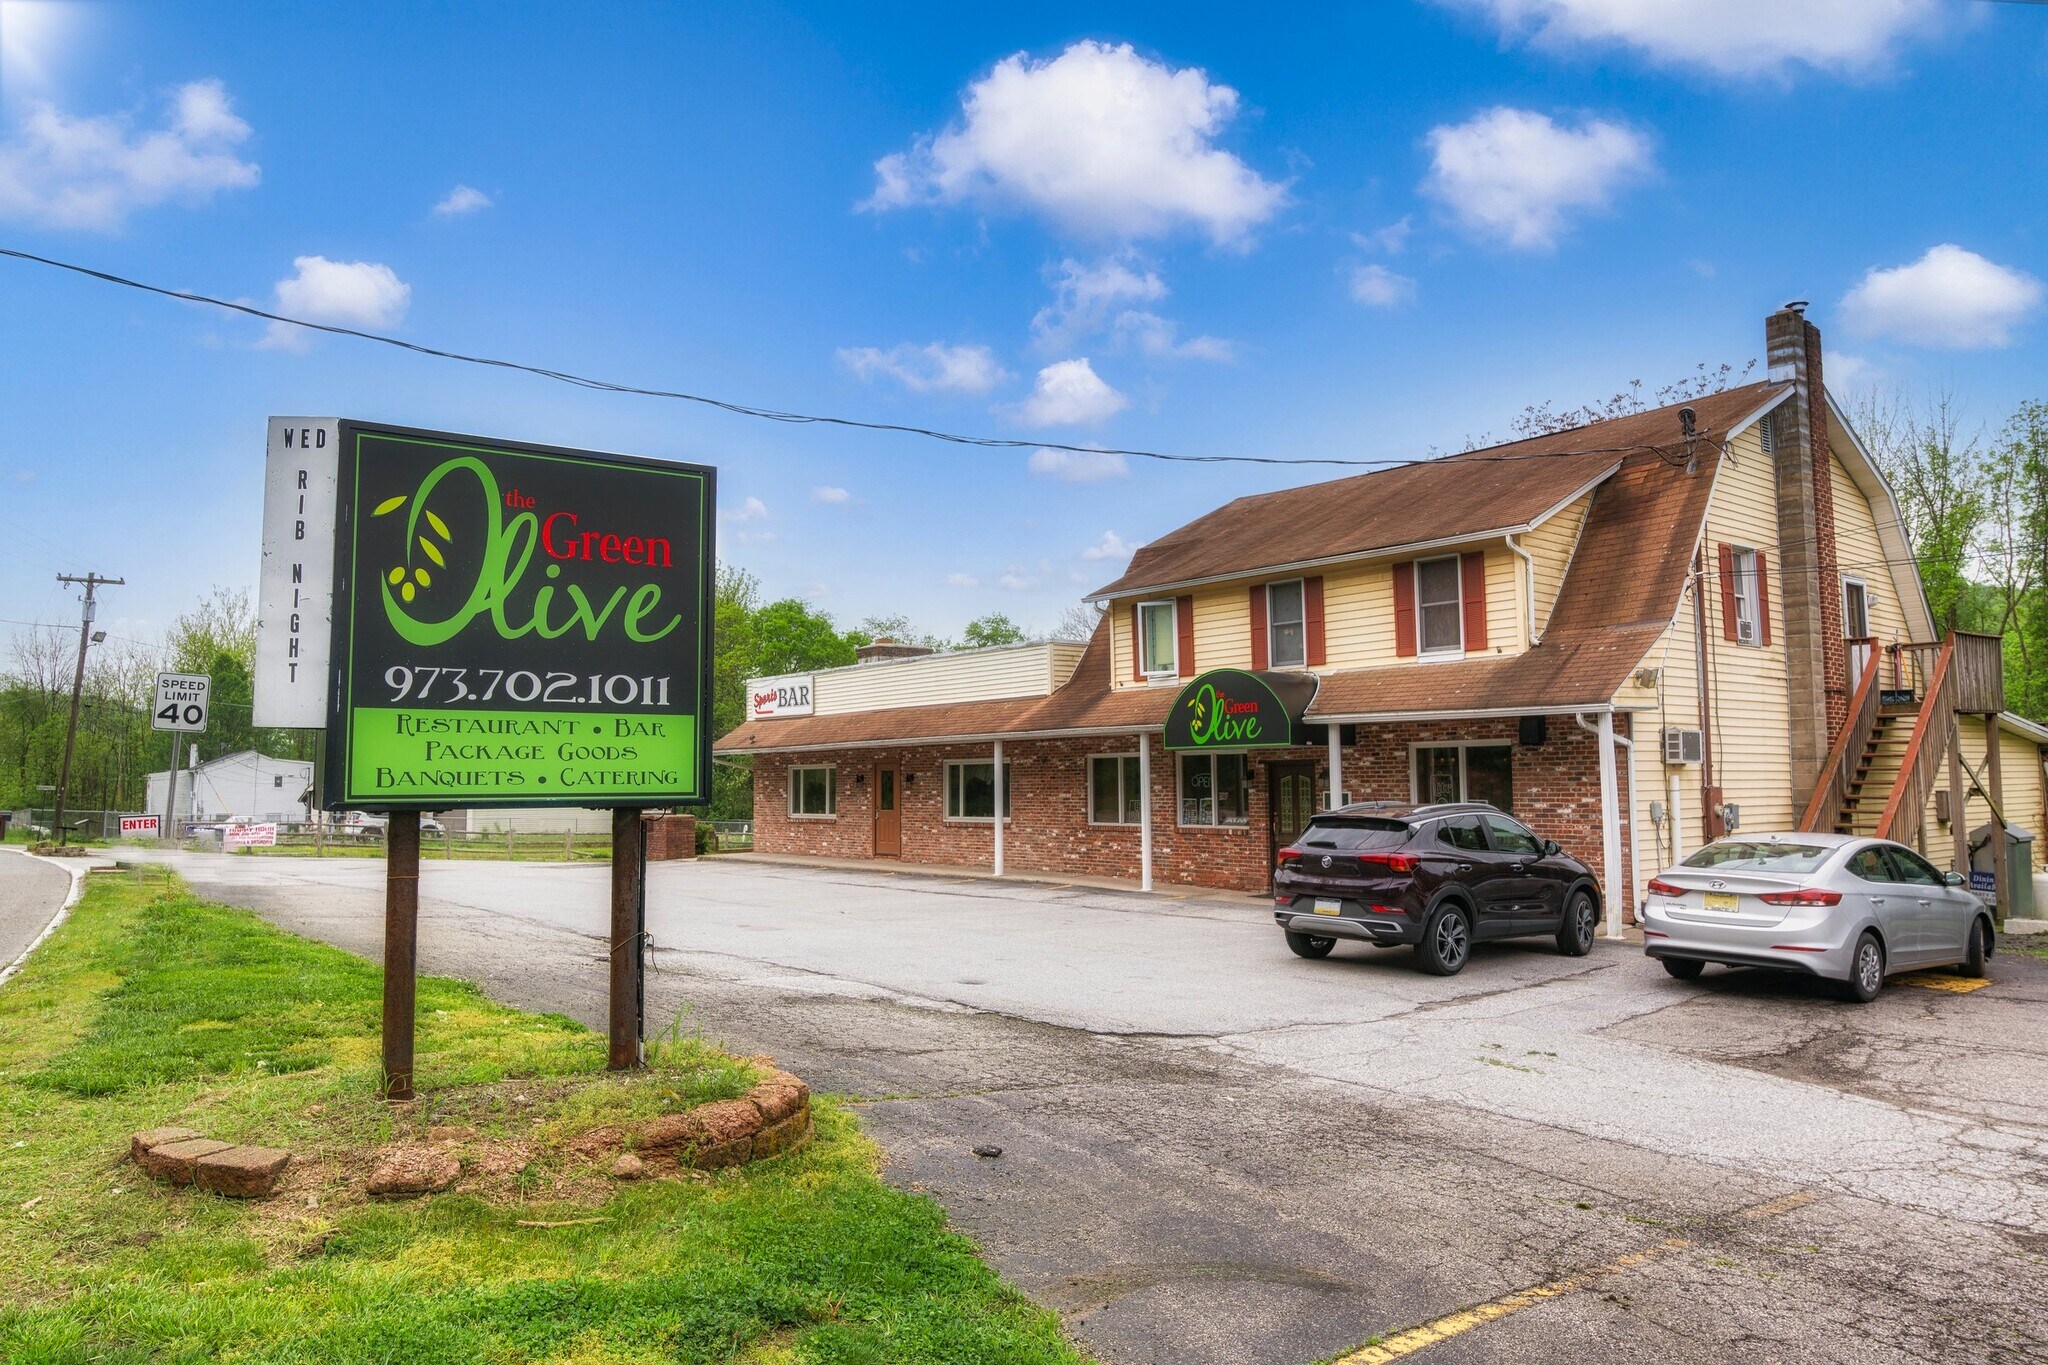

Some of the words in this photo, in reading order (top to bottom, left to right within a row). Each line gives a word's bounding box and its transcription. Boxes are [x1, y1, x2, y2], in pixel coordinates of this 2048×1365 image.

[284, 428, 326, 449] WED
[294, 469, 308, 541] RIB
[505, 489, 536, 510] the
[542, 511, 674, 569] Green
[381, 456, 682, 647] Olive
[288, 563, 303, 683] NIGHT
[161, 679, 206, 691] SPEED
[384, 665, 670, 706] 973.702.1011
[164, 691, 201, 702] LIMIT
[754, 688, 778, 709] Sports
[777, 685, 810, 708] BAR
[1224, 698, 1259, 714] Green
[157, 703, 204, 725] 40
[1189, 683, 1262, 745] Olive
[396, 713, 582, 737] RESTAURANT
[615, 718, 666, 738] BAR
[425, 740, 546, 762] PACKAGE
[558, 742, 638, 762] GOODS
[375, 766, 526, 789] BANQUETS
[560, 767, 679, 787] CATERING
[1191, 776, 1211, 788] OPE
[122, 818, 157, 830] ENTER
[1973, 875, 1995, 883] Dinin
